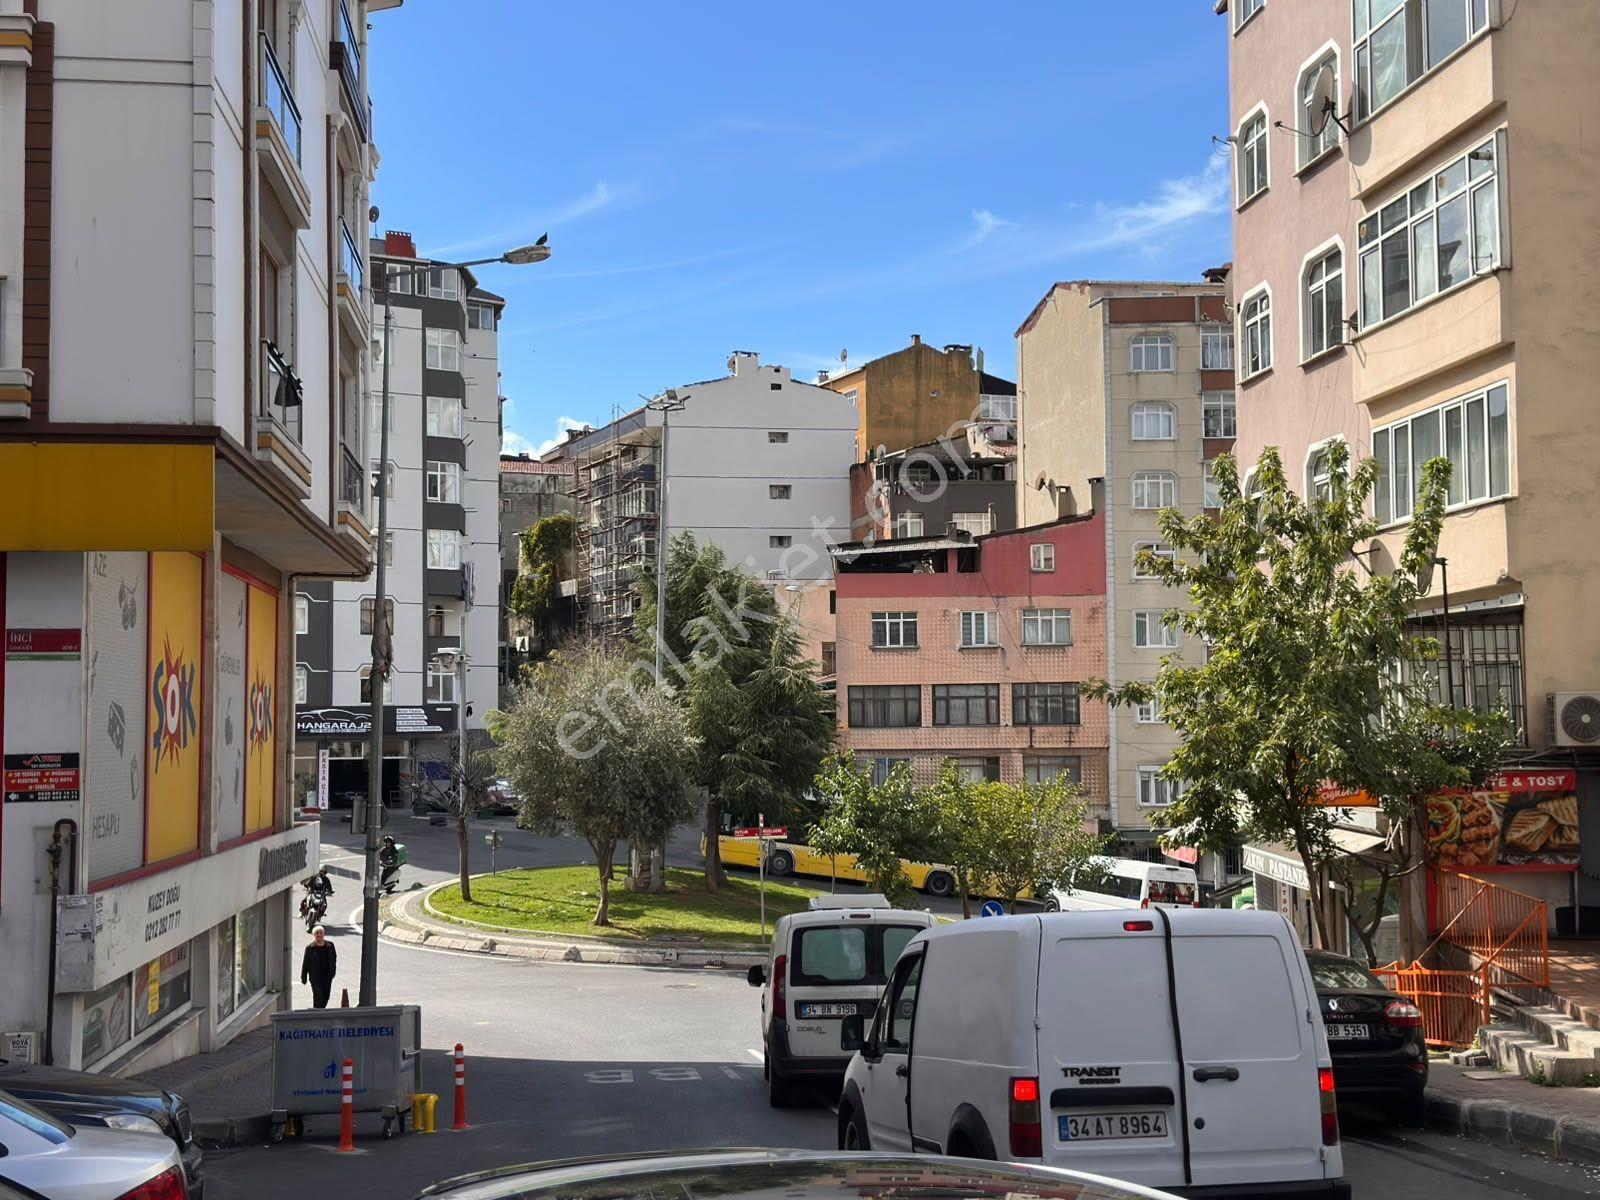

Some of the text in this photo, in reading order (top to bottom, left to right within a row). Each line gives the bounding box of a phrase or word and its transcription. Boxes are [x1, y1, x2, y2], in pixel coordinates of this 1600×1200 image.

[1512, 778, 1522, 787] &
[1527, 776, 1566, 787] TOST
[1344, 1024, 1367, 1036] 5351
[1061, 1066, 1121, 1077] TRANSIT
[1069, 1114, 1162, 1138] 34 AT 8964
